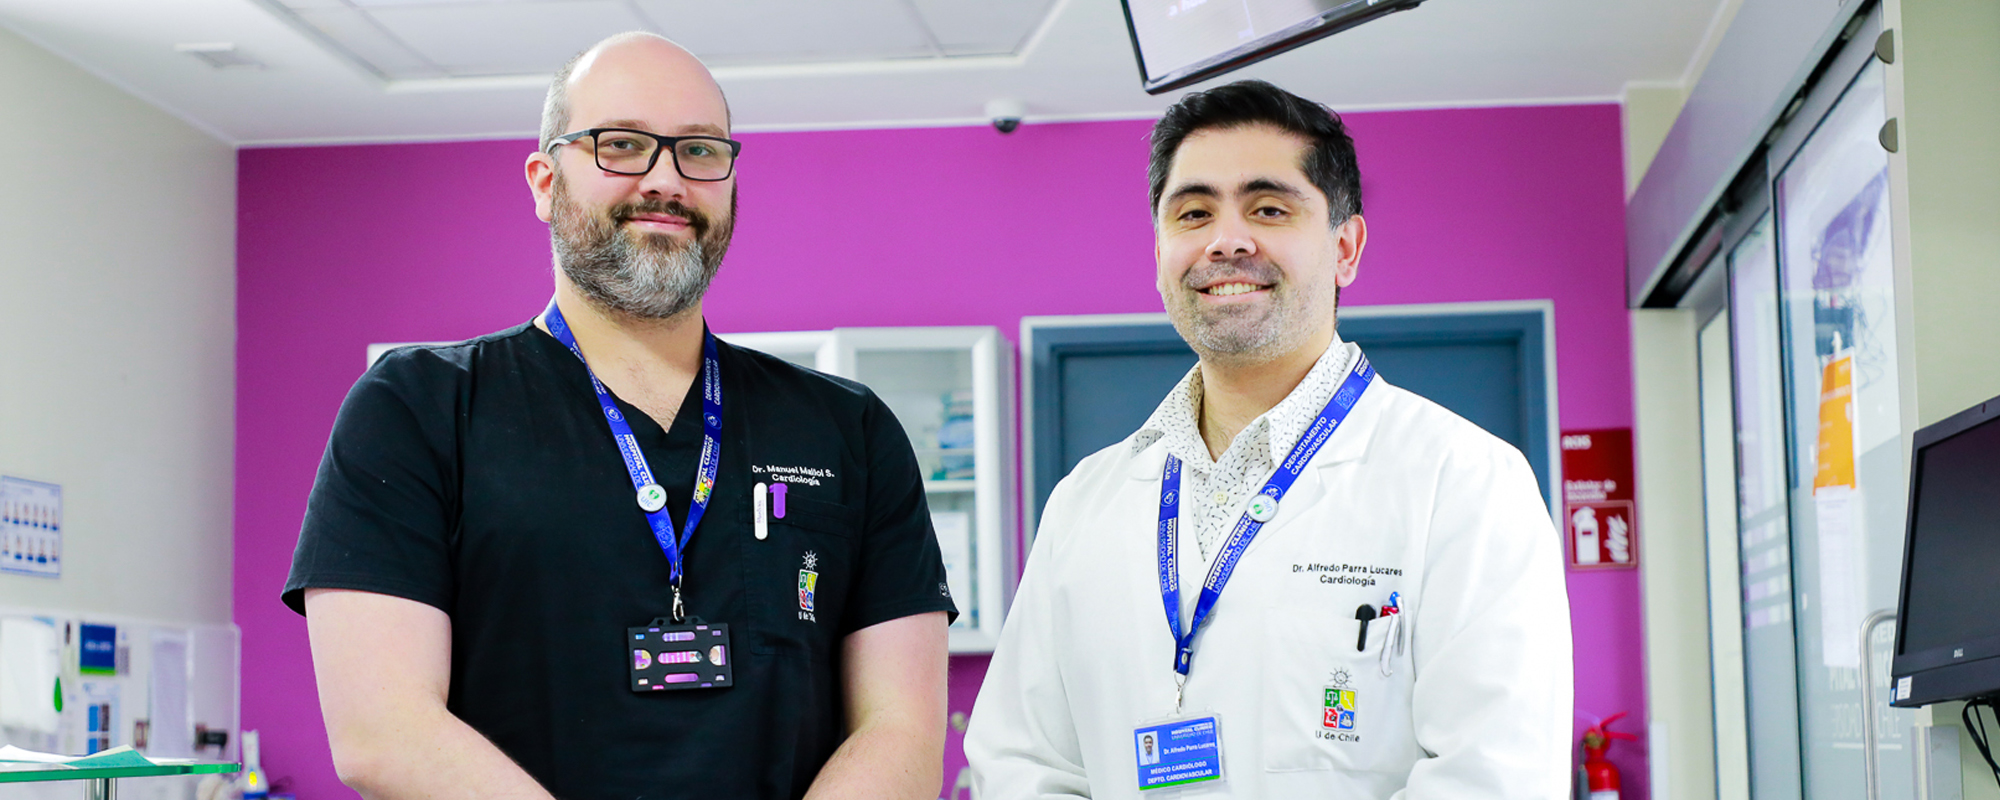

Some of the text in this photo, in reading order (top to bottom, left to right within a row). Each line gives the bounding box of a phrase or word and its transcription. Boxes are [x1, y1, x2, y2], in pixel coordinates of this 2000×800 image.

[622, 433, 644, 470] HOSPITAL
[703, 435, 714, 466] CLINICO
[1284, 416, 1327, 470] DEPARTAMENTO
[1291, 418, 1338, 475] CARDIOVASCULAR
[752, 465, 766, 473] Dr.
[766, 465, 800, 474] Manuel
[825, 469, 835, 478] S.
[771, 474, 821, 486] Cardiología
[1166, 557, 1175, 591] CLINICO
[1207, 547, 1232, 589] HOSPITAL
[1292, 563, 1403, 577] Dr. Alfredo Parra Lucares
[1319, 574, 1376, 587] Cardiología
[1315, 730, 1360, 742] U de Chile
[1166, 769, 1213, 781] CARDIOVASCULAR
